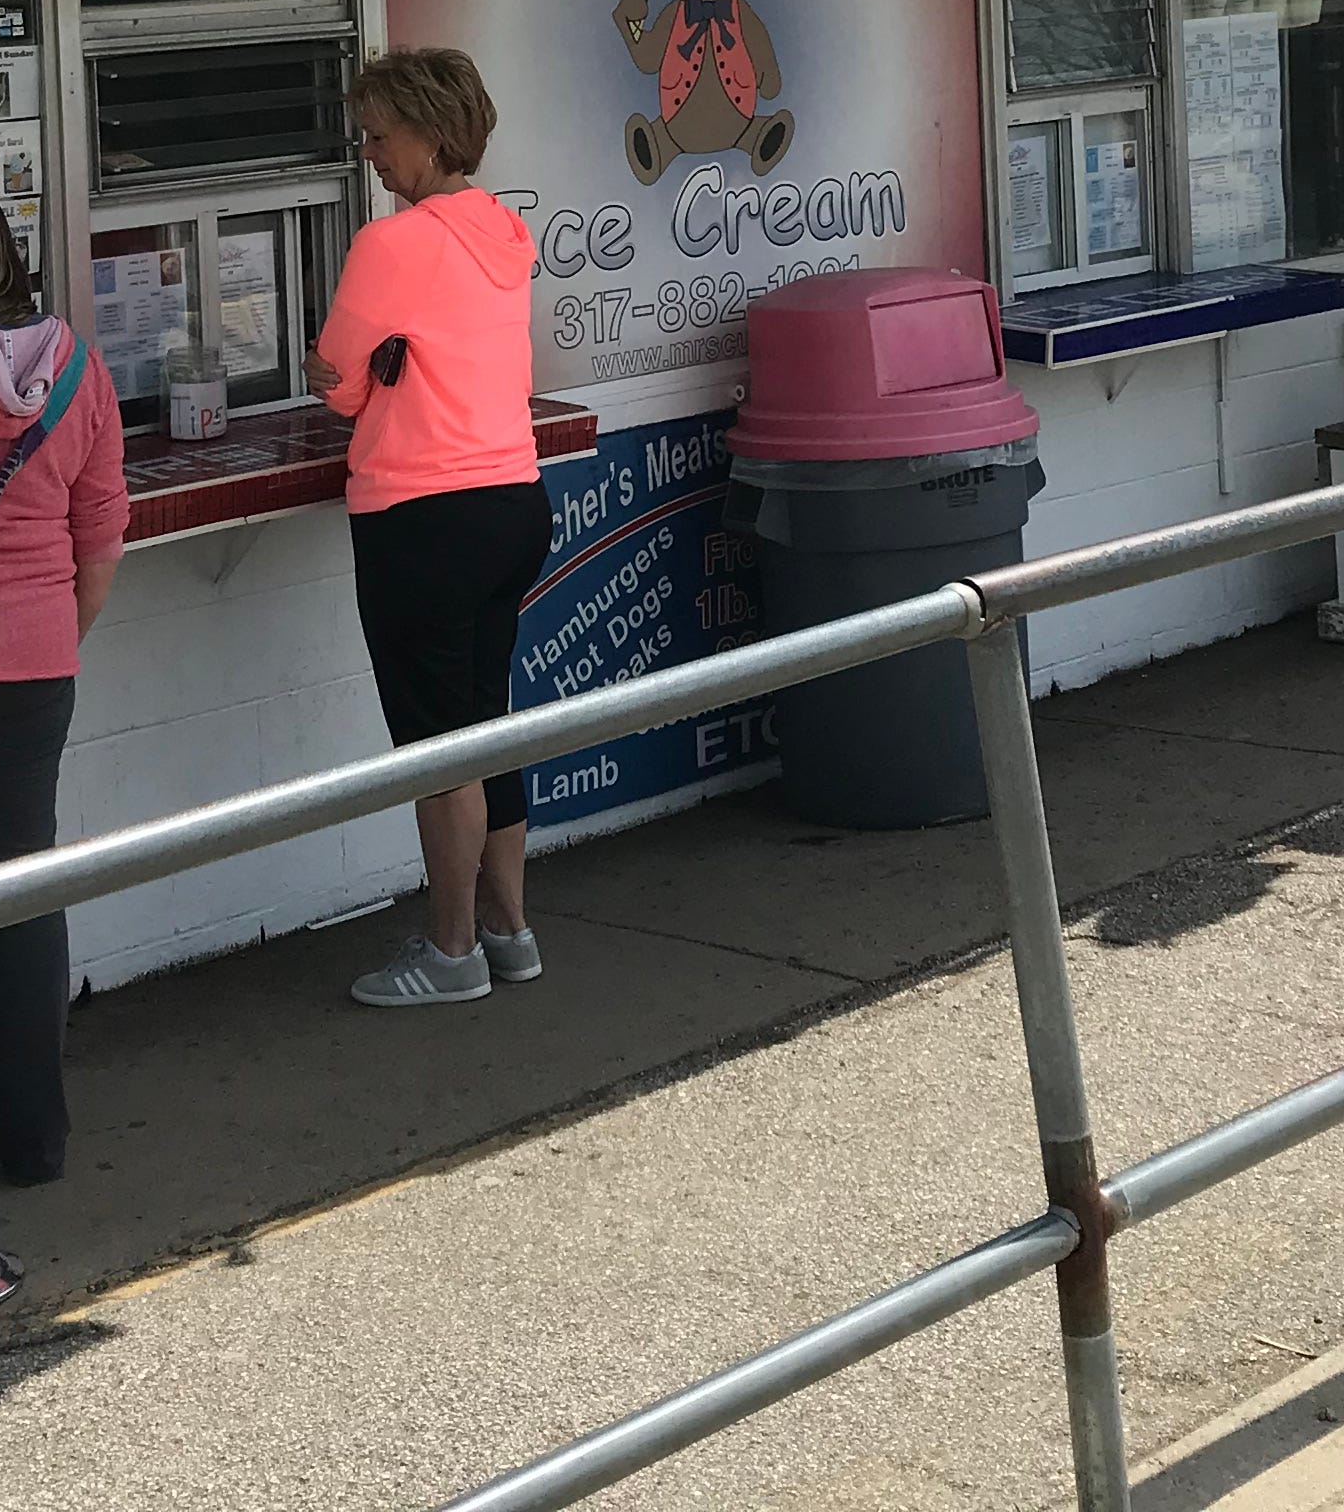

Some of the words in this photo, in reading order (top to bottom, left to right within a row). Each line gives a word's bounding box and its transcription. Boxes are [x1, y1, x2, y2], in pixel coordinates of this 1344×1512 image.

[4, 50, 34, 59] Sundae
[494, 189, 635, 279] ce
[672, 165, 906, 258] Cream
[553, 254, 860, 349] 317-882-
[645, 424, 727, 493] Meats
[521, 526, 674, 683] Hamburgers
[553, 642, 604, 699] Hot
[606, 575, 673, 649] Dogs
[604, 624, 673, 686] eaks
[532, 755, 619, 806] Lamb
